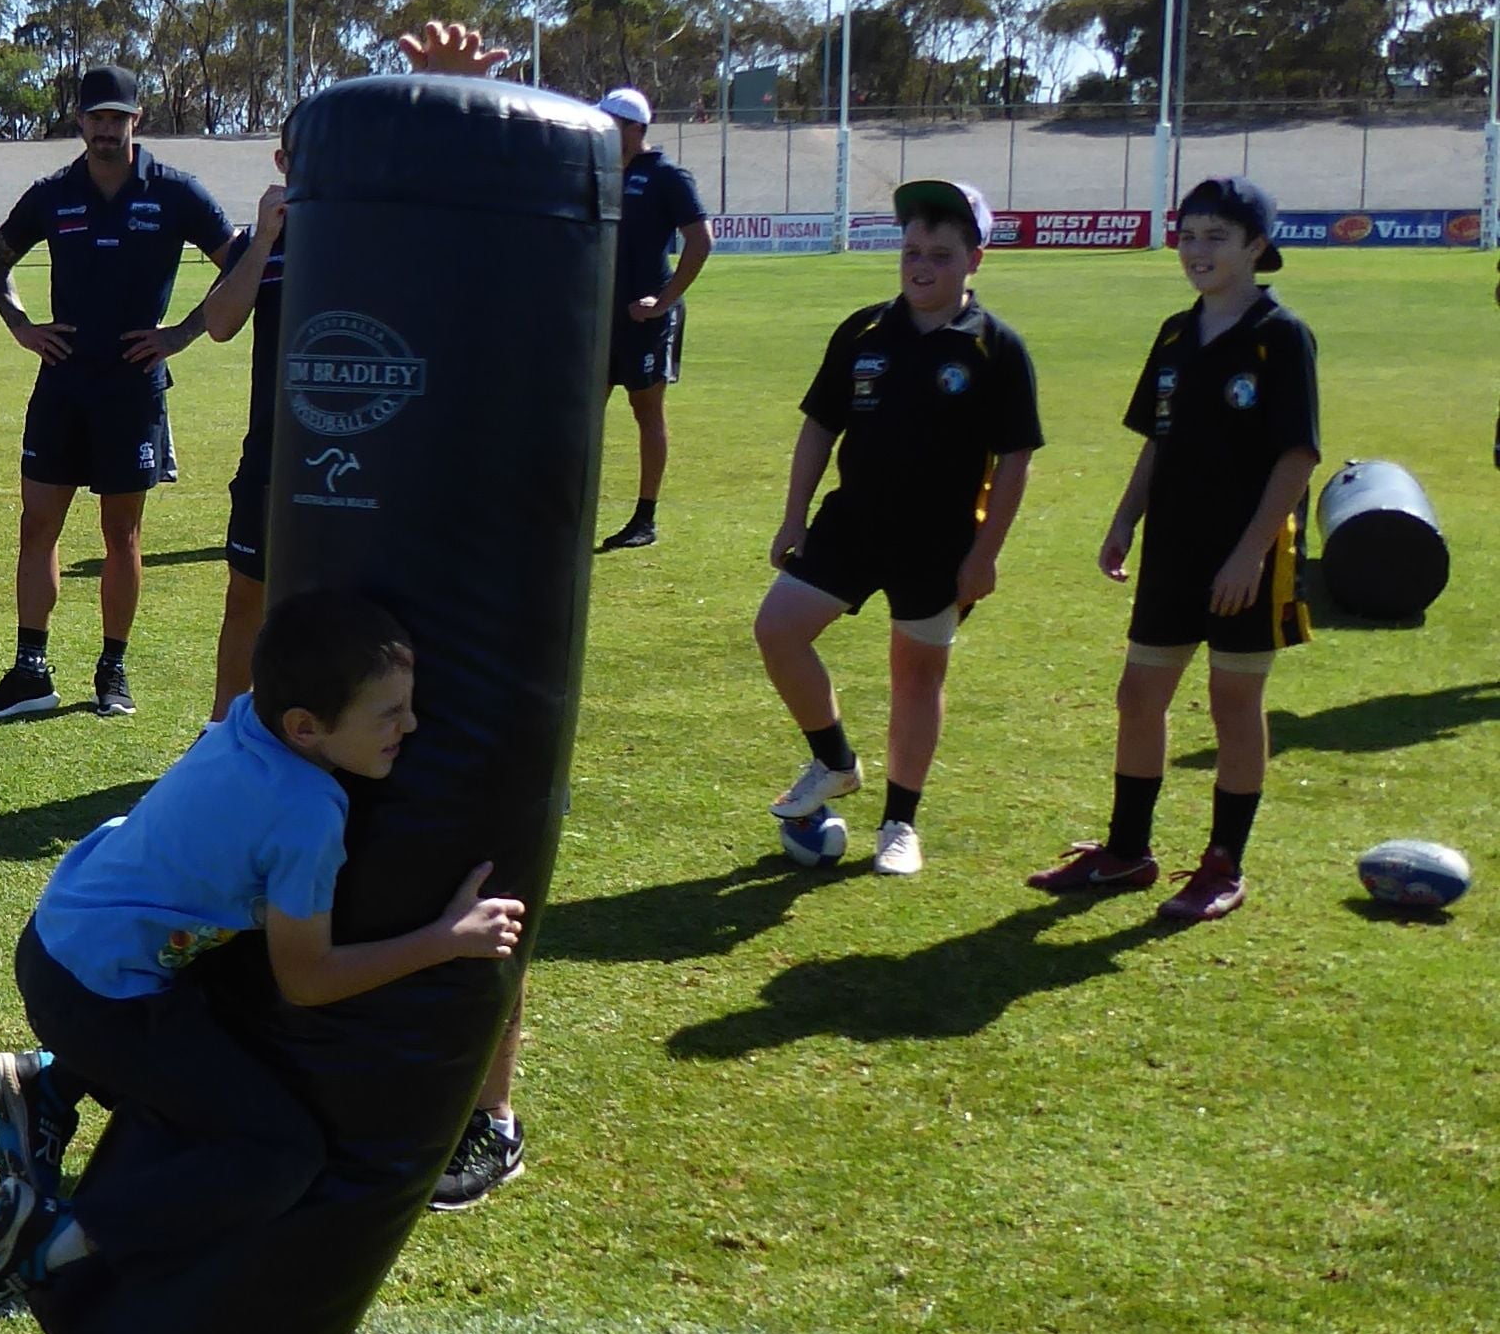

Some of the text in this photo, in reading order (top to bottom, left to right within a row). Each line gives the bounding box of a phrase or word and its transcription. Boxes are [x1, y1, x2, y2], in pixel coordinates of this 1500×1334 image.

[712, 217, 771, 238] GRAND
[776, 222, 821, 238] NISSAN
[1036, 215, 1142, 229] WEST END
[1035, 231, 1137, 245] DRAUGHT
[313, 362, 417, 386] BRADLEY
